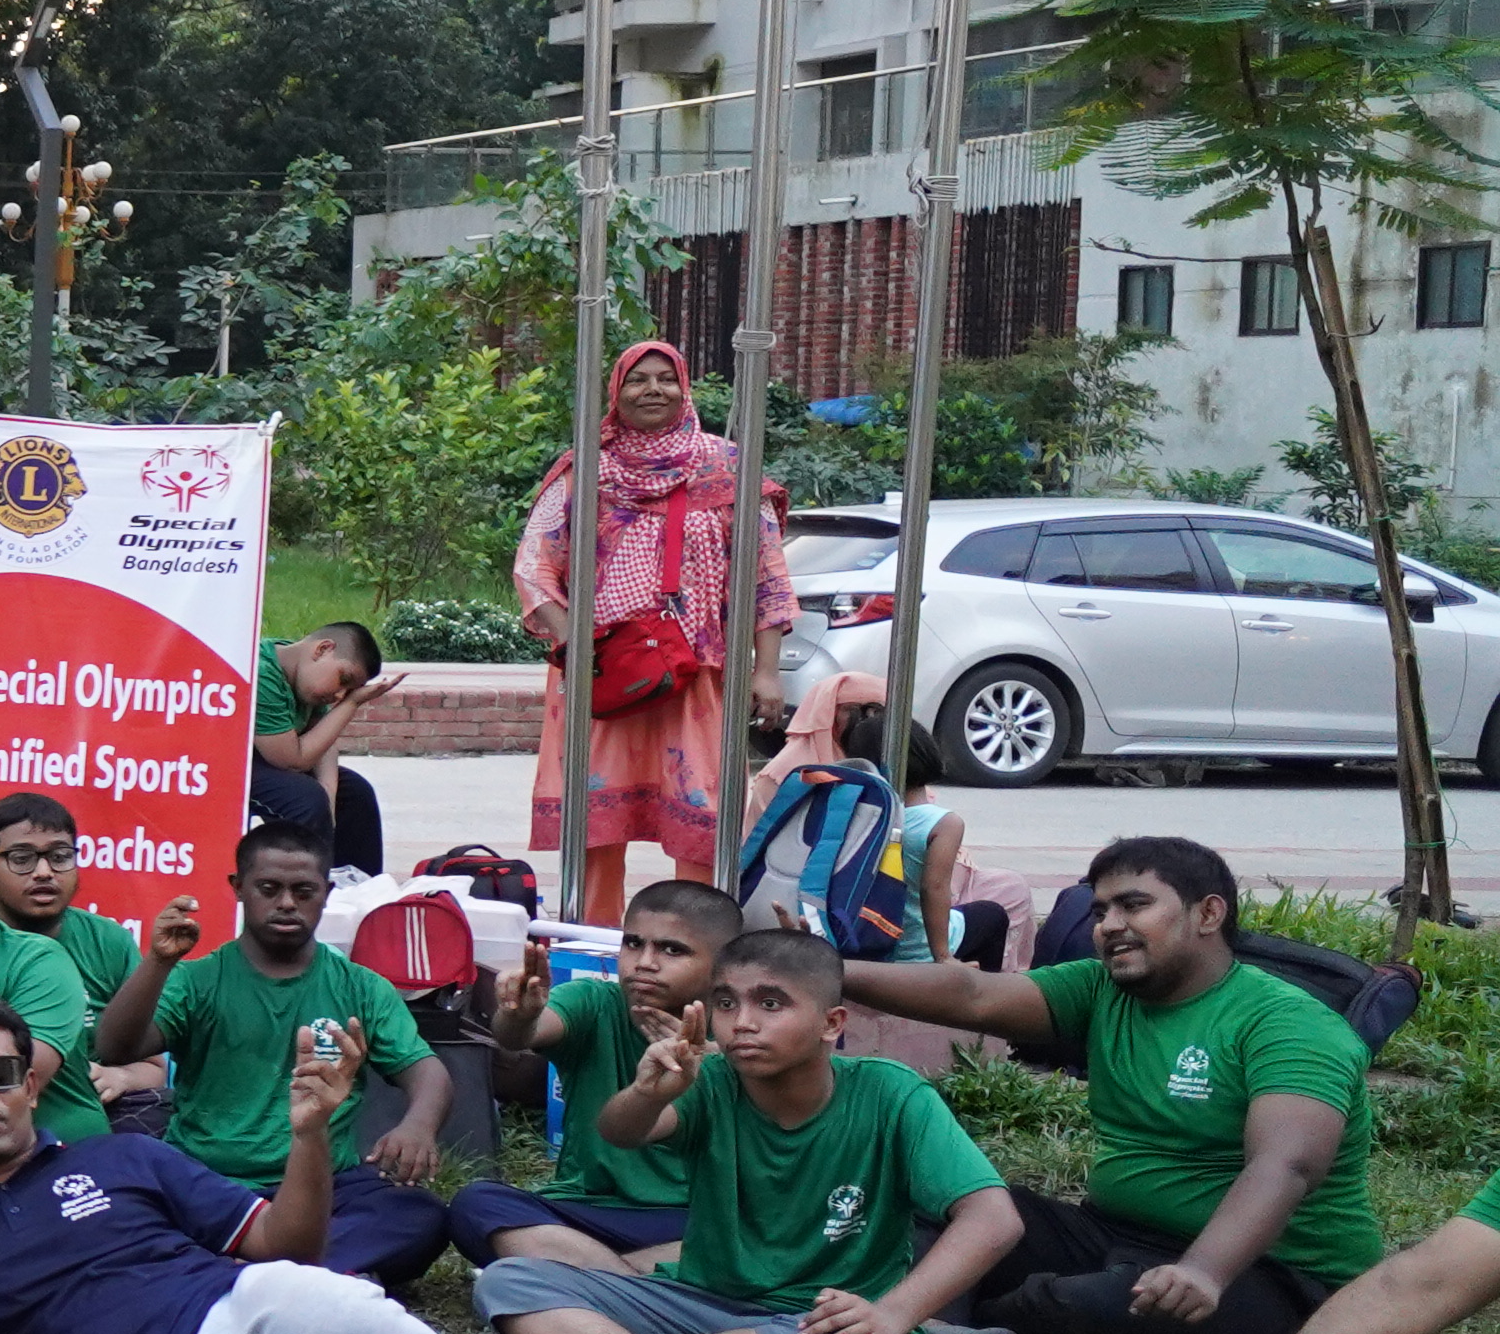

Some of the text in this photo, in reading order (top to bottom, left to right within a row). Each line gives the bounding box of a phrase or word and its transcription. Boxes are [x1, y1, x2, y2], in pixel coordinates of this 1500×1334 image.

[4, 439, 66, 460] LIONS
[20, 466, 48, 501] L
[128, 515, 237, 531] Special
[8, 533, 88, 564] FOUNDATION
[118, 533, 246, 552] Olympics
[123, 555, 238, 575] Bangladesh
[74, 663, 236, 725] Olympics
[94, 745, 208, 801] Sports
[76, 826, 194, 875] oaches
